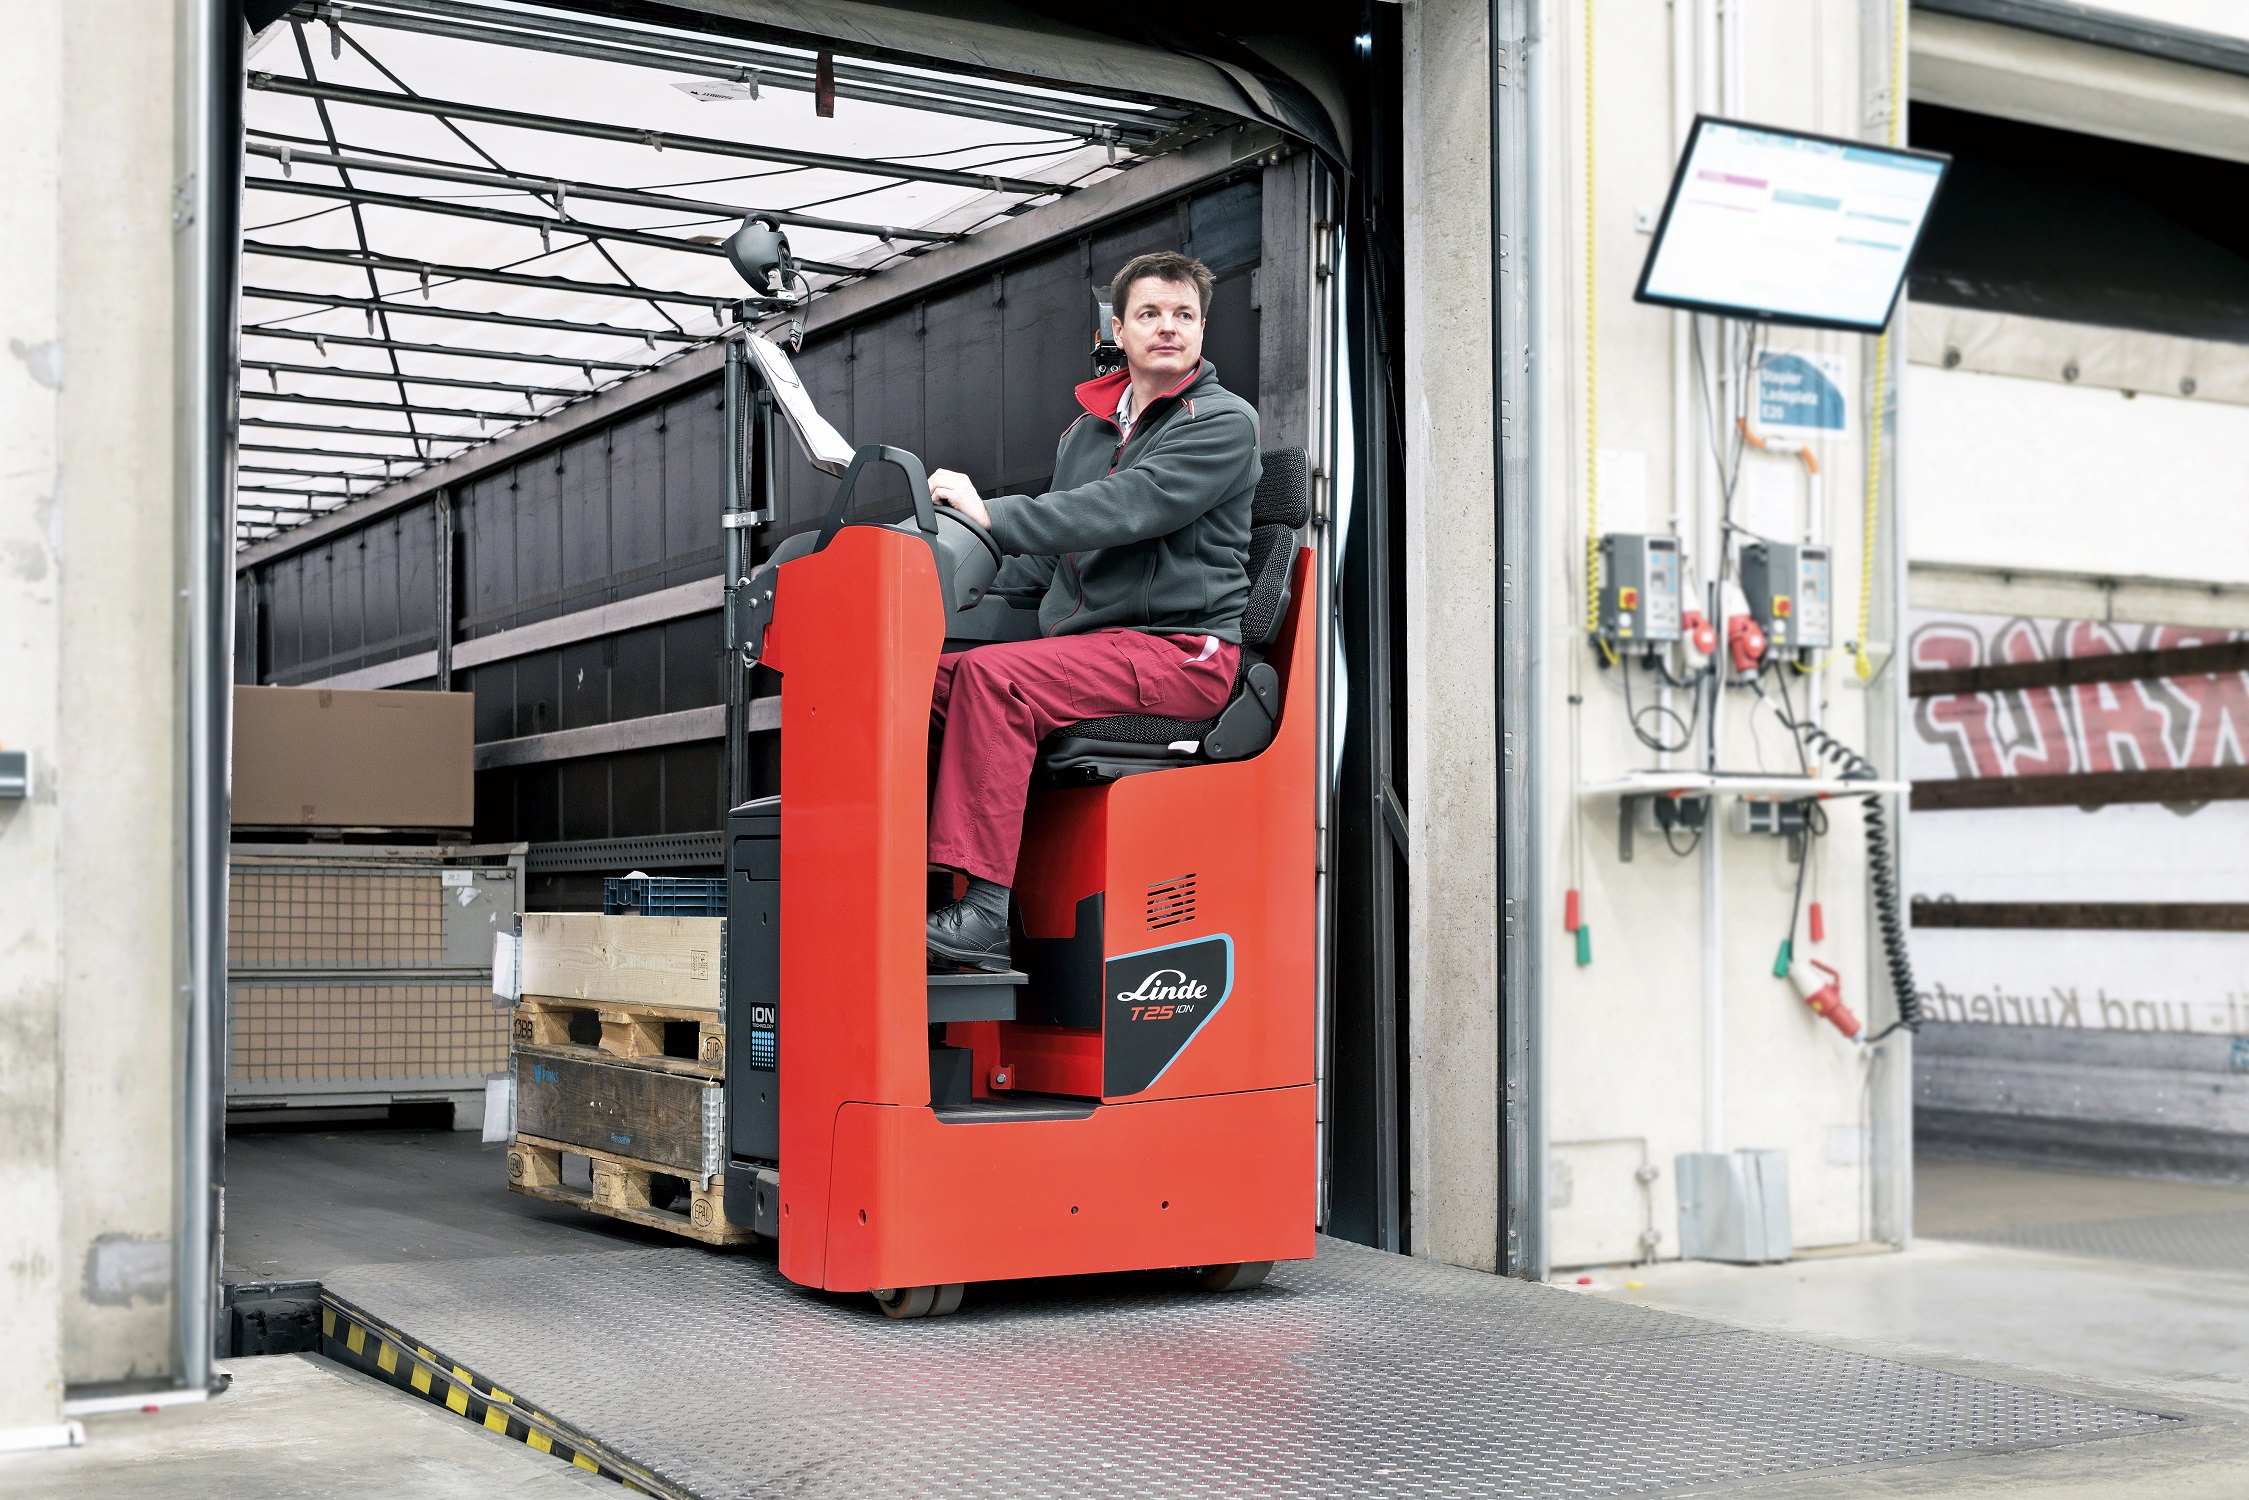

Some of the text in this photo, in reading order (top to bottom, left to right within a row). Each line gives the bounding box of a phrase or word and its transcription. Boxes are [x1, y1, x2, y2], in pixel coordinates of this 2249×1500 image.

[1117, 969, 1208, 1002] Linde
[751, 1006, 775, 1024] ION
[1175, 1004, 1194, 1014] ION
[706, 1041, 720, 1061] EUR
[510, 1156, 523, 1174] EPAL
[695, 1203, 710, 1223] EPAL
